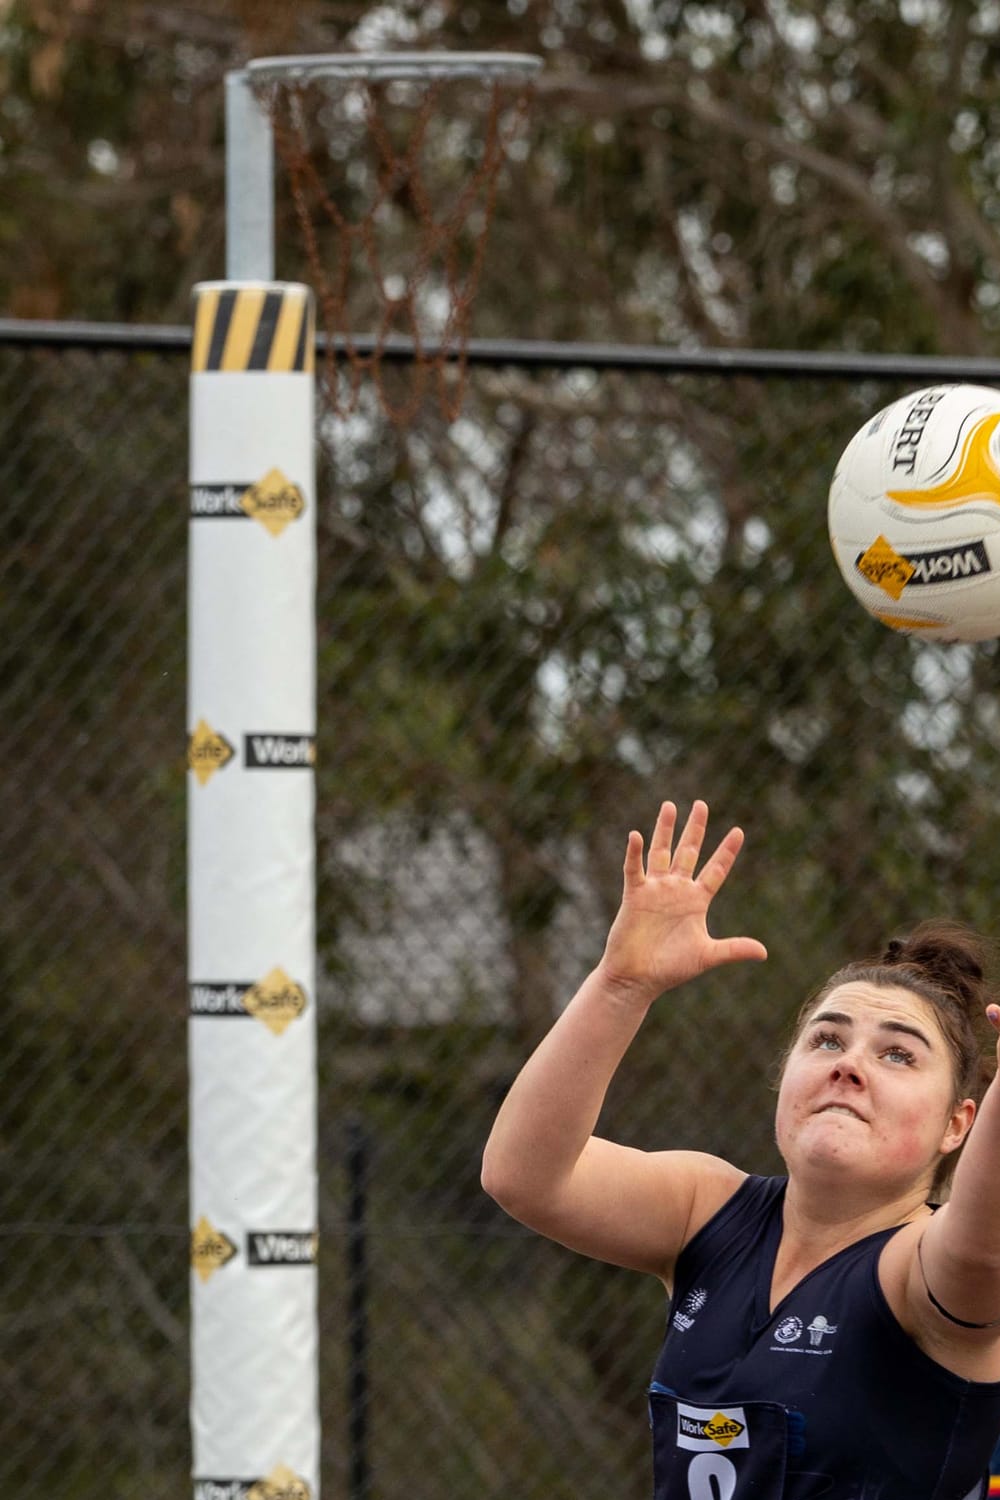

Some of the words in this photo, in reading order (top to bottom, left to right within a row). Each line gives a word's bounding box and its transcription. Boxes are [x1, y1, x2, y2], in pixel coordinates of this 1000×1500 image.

[893, 391, 946, 476] BERT
[681, 1418, 705, 1436] Work
[708, 1422, 738, 1436] Safe
